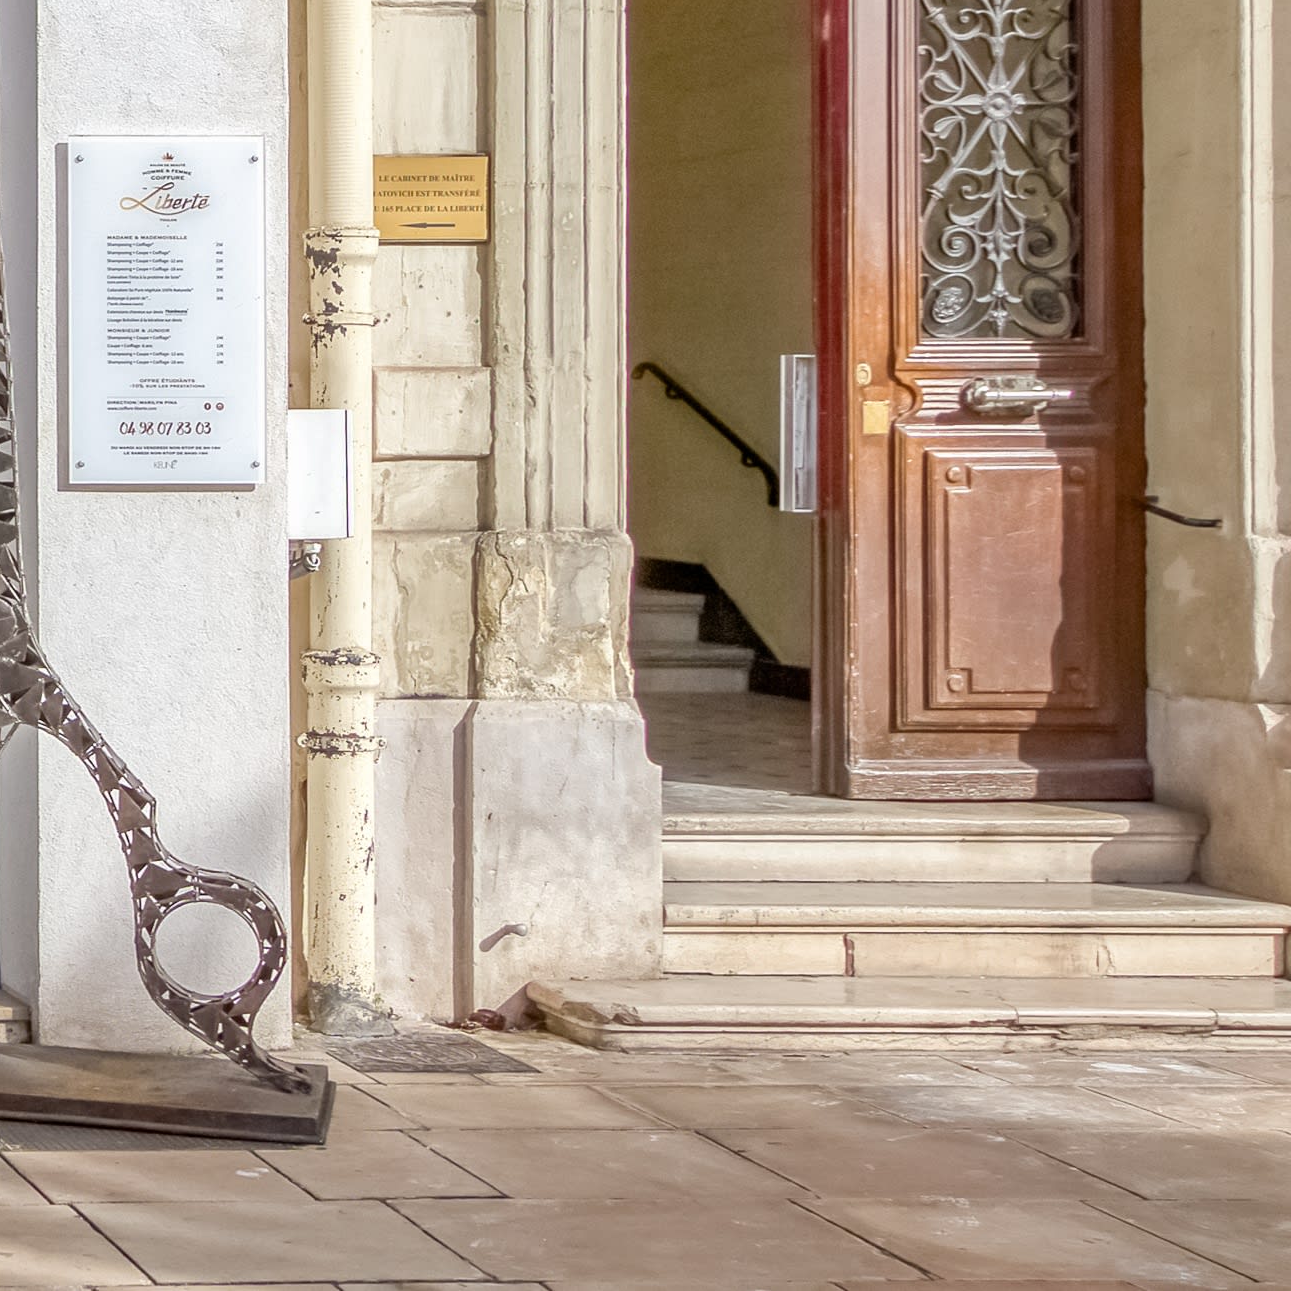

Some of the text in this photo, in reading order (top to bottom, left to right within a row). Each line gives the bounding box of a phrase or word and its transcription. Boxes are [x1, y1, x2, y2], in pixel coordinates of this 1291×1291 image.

[441, 173, 475, 182] MAÎTRE
[373, 189, 481, 198] ATOVICH EST TRANSFÉRÉ
[120, 181, 211, 216] Liberté
[449, 204, 484, 213] LIBERTÉ
[119, 421, 212, 436] 04 98 07 83 03
